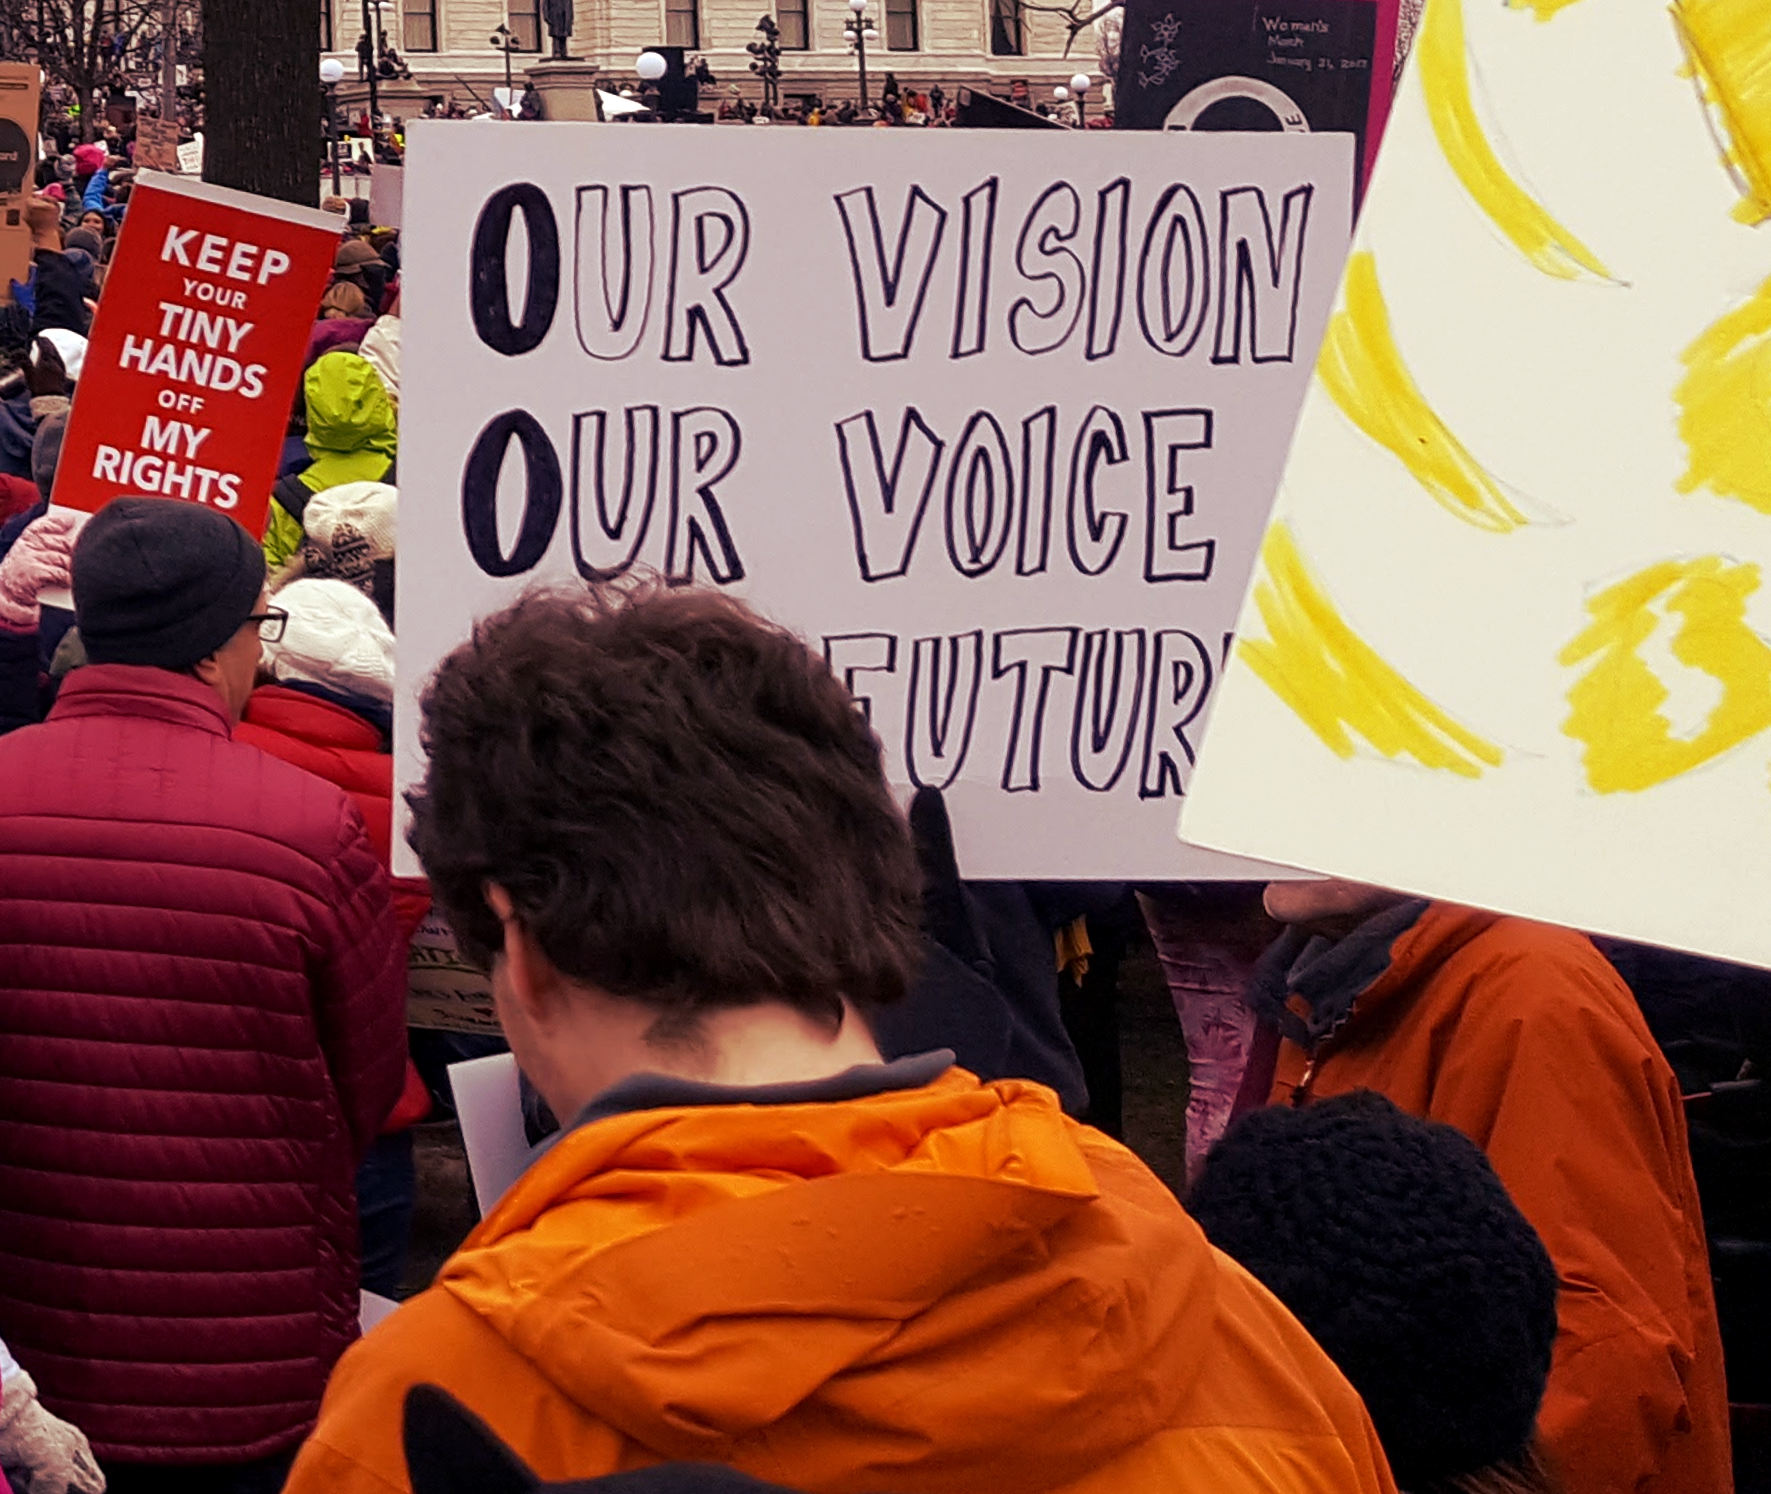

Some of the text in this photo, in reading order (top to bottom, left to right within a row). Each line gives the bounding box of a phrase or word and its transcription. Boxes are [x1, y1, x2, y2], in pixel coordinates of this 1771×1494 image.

[160, 225, 291, 287] KEEP
[469, 176, 1314, 366] OUR VISION
[182, 278, 248, 310] YOUR
[159, 301, 254, 353] TINY
[118, 334, 268, 399] HANDS
[157, 389, 205, 415] OFF
[140, 415, 211, 460] MY
[92, 445, 241, 509] RIGHTS
[460, 403, 1217, 586] OUR VOICE
[822, 627, 1235, 800] FUTUR
